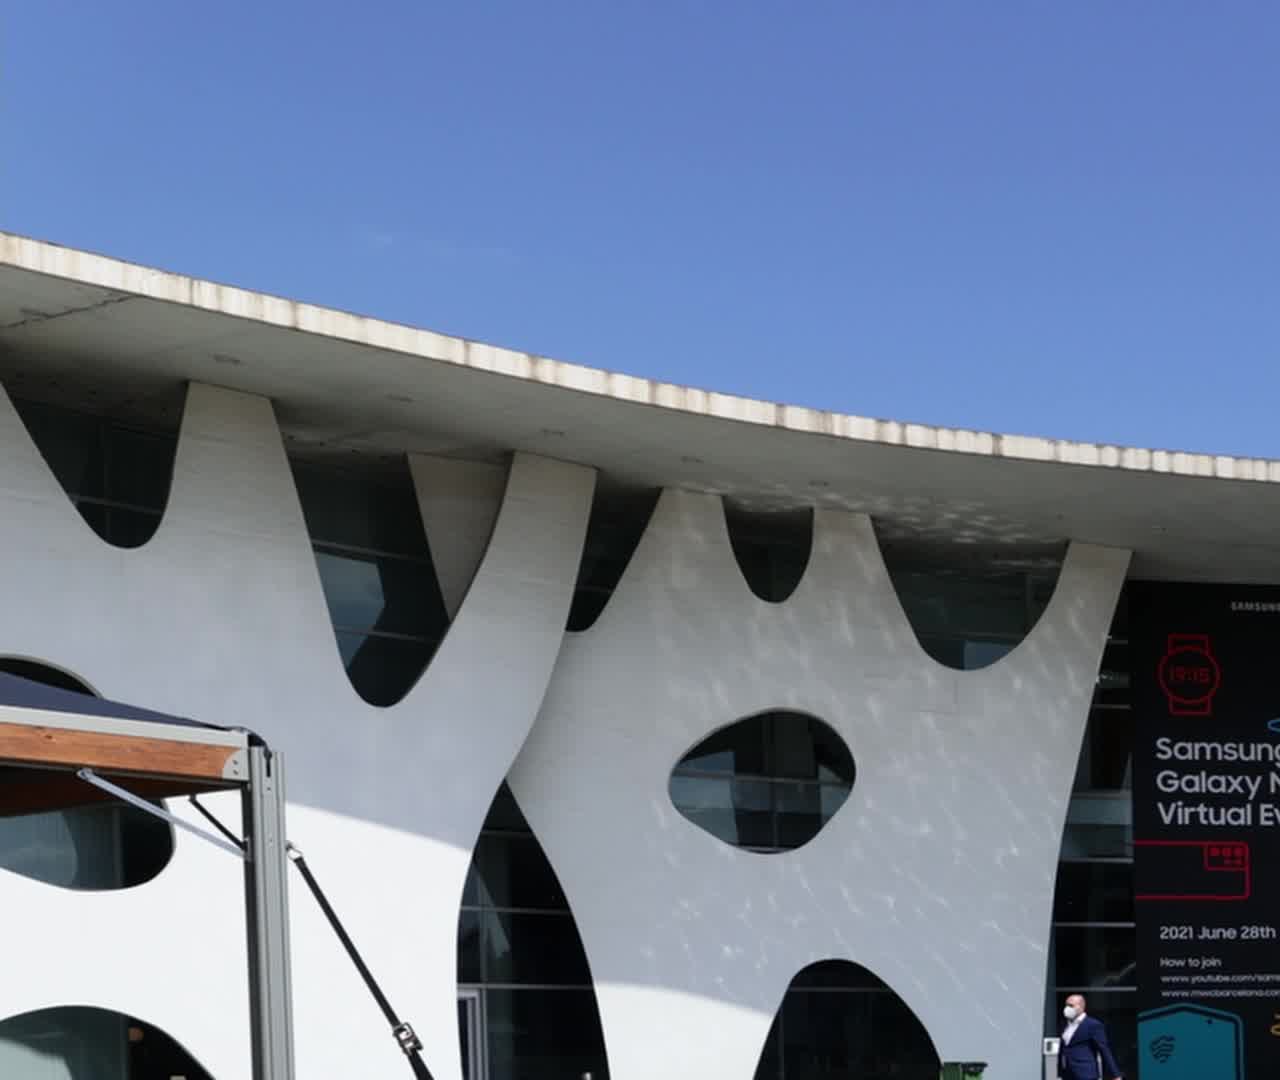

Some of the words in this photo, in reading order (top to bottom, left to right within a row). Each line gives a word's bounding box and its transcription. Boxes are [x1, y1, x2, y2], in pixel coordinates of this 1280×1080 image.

[1156, 770, 1262, 800] Galaxy
[1157, 801, 1251, 826] Virtual
[1159, 926, 1194, 940] 2021
[1198, 926, 1238, 940] June
[1240, 925, 1277, 940] 28th
[1159, 957, 1186, 968] How
[1187, 957, 1200, 968] to
[1201, 957, 1222, 969] join
